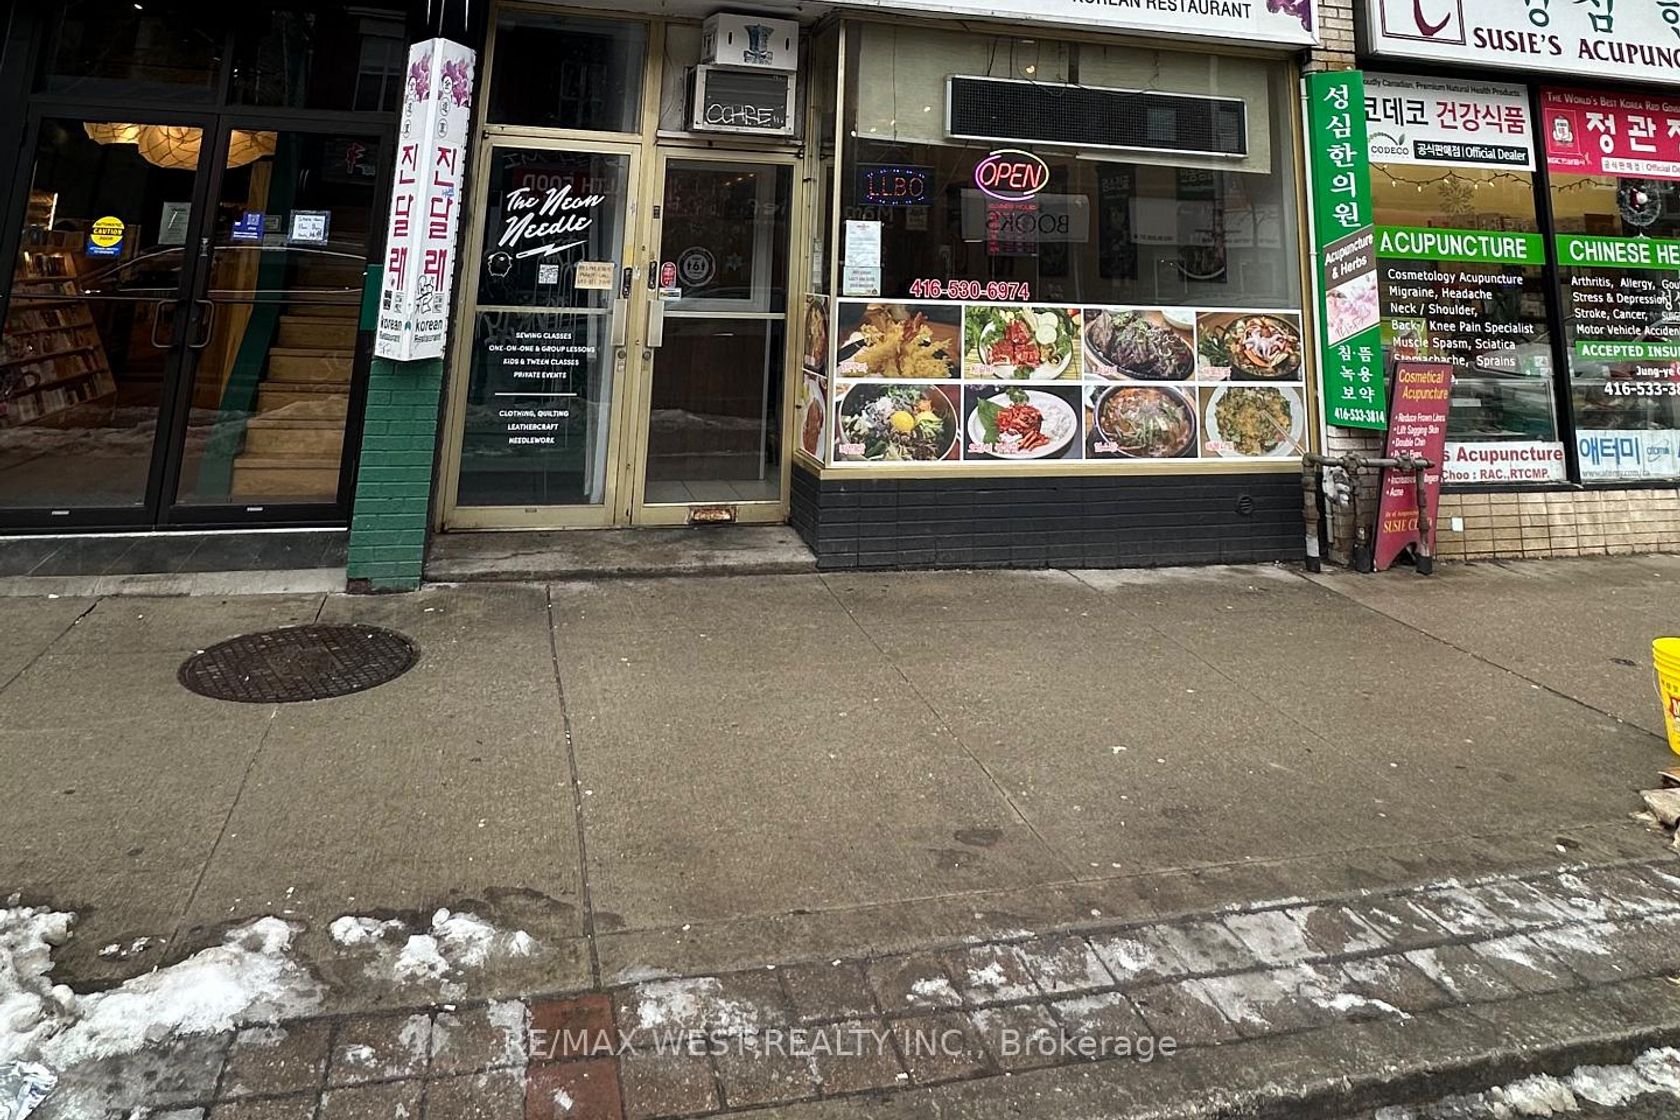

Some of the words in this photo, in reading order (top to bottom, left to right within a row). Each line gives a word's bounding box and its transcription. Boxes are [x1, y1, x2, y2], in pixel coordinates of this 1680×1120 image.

[1473, 27, 1562, 55] SUSIE'S
[1416, 81, 1445, 91] Premium
[1470, 85, 1491, 94] Health
[1436, 101, 1525, 134] 건강식품
[1371, 145, 1409, 156] CODECO
[1466, 146, 1496, 159] Official
[1499, 148, 1526, 161] Dealer
[980, 163, 1042, 188] OPEN
[866, 177, 924, 197] LLBO
[506, 187, 539, 211] The
[539, 184, 605, 216] Neon
[498, 212, 593, 247] Needle
[1325, 233, 1374, 266] Acupuncture
[1380, 231, 1527, 258] ACUPUNCTURE
[1569, 240, 1651, 263] CHINESE
[1332, 267, 1339, 280] &
[1340, 255, 1367, 275] Herbs
[1388, 269, 1456, 283] Cosmetology
[1459, 272, 1523, 285] Acupuncture
[1571, 276, 1614, 289] Arthritis,
[1620, 277, 1656, 290] Allergy,
[1661, 279, 1680, 290] Gou
[910, 278, 1030, 301] 416-530-6974
[1389, 286, 1439, 300] Migraine,
[1441, 288, 1493, 300] Headache
[1573, 292, 1604, 302] Stress
[1606, 293, 1614, 303] &
[1390, 302, 1417, 314] Neck
[1428, 304, 1478, 317] Shoulder,
[1574, 308, 1610, 320] Stroke,
[1612, 309, 1648, 321] Cancer,
[415, 318, 443, 331] korean
[1429, 321, 1456, 332] Knee
[1459, 321, 1481, 332] Pain
[1484, 322, 1534, 335] Specialist
[1576, 324, 1604, 335] Motor
[1607, 325, 1641, 335] Vehicle
[1644, 326, 1680, 336] Acciden
[1392, 337, 1429, 348] Muscle
[1432, 338, 1472, 351] Spasm,
[1475, 339, 1516, 350] Sciatica
[1582, 344, 1643, 357] ACCEPTED
[1648, 346, 1680, 357] INSU
[1476, 356, 1516, 367] Sprains
[1399, 369, 1444, 384] Cosmetical
[1402, 385, 1448, 401] Acupuncture
[1334, 407, 1385, 423] 416-533-3814
[1456, 446, 1563, 465] Acupuncture
[1580, 437, 1641, 465] 애터미
